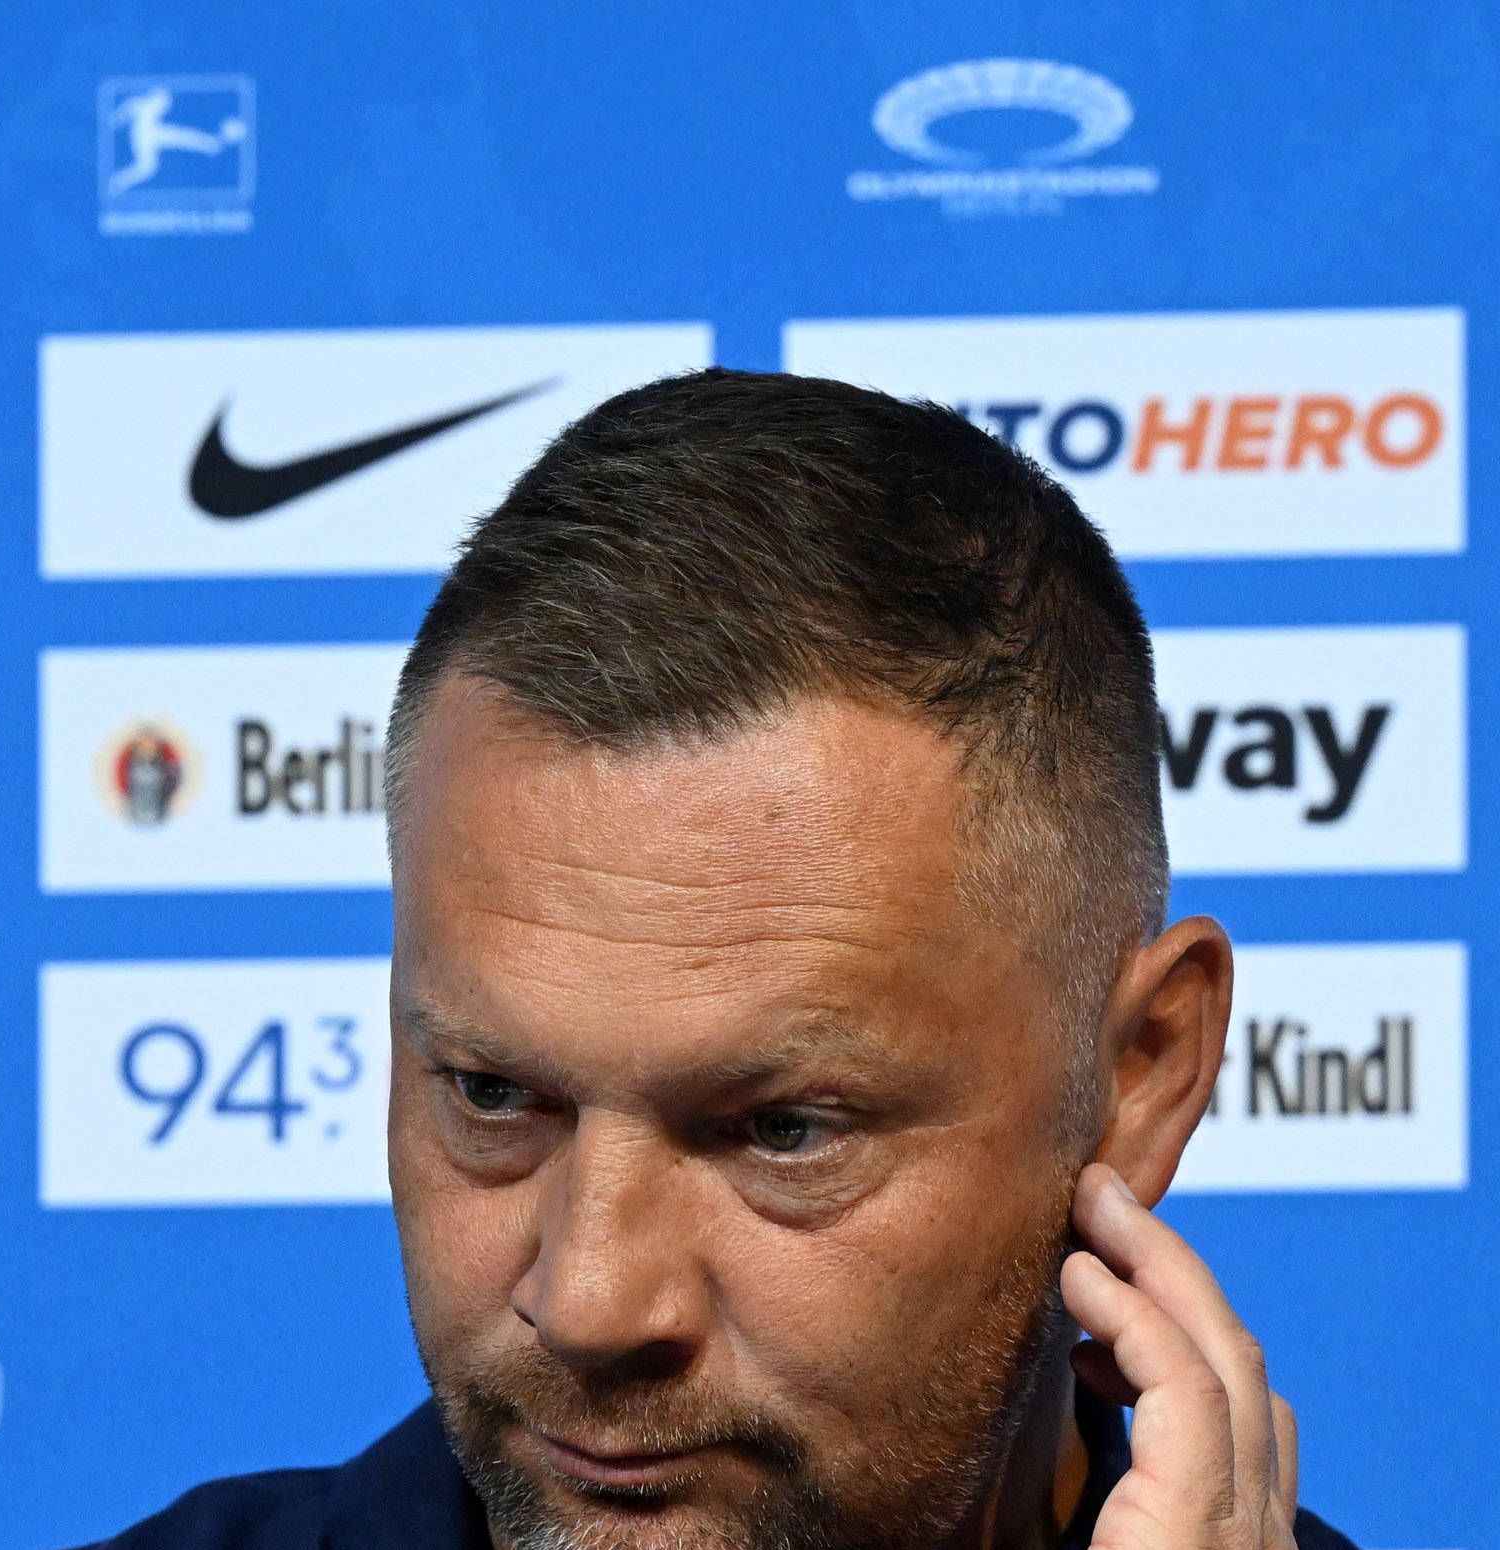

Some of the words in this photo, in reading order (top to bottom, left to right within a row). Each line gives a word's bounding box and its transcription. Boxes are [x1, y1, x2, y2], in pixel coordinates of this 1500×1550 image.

[957, 394, 1443, 476] TOHERO
[234, 716, 385, 822] Berli
[1244, 1014, 1415, 1121] Kindl
